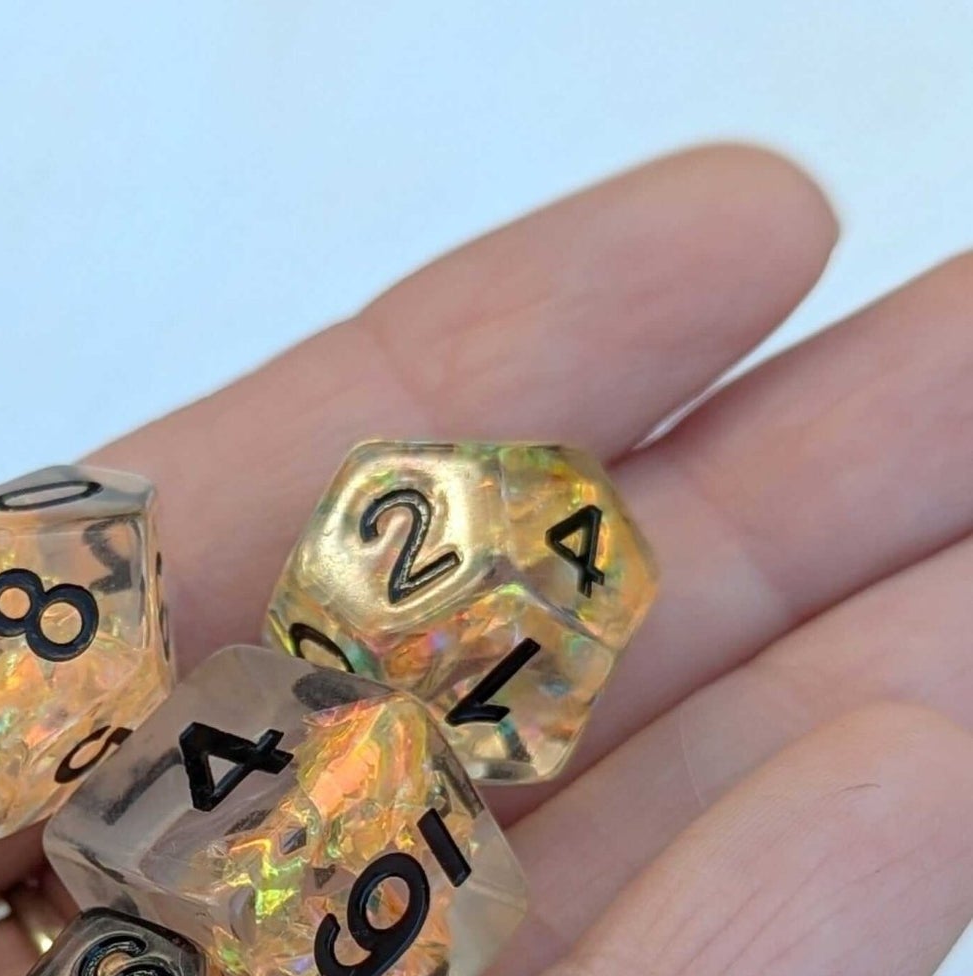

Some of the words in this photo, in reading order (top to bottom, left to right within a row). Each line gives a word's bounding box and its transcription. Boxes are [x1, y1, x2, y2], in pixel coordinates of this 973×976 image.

[360, 488, 461, 604] 2
[545, 504, 604, 598] 4
[179, 722, 294, 811] 4
